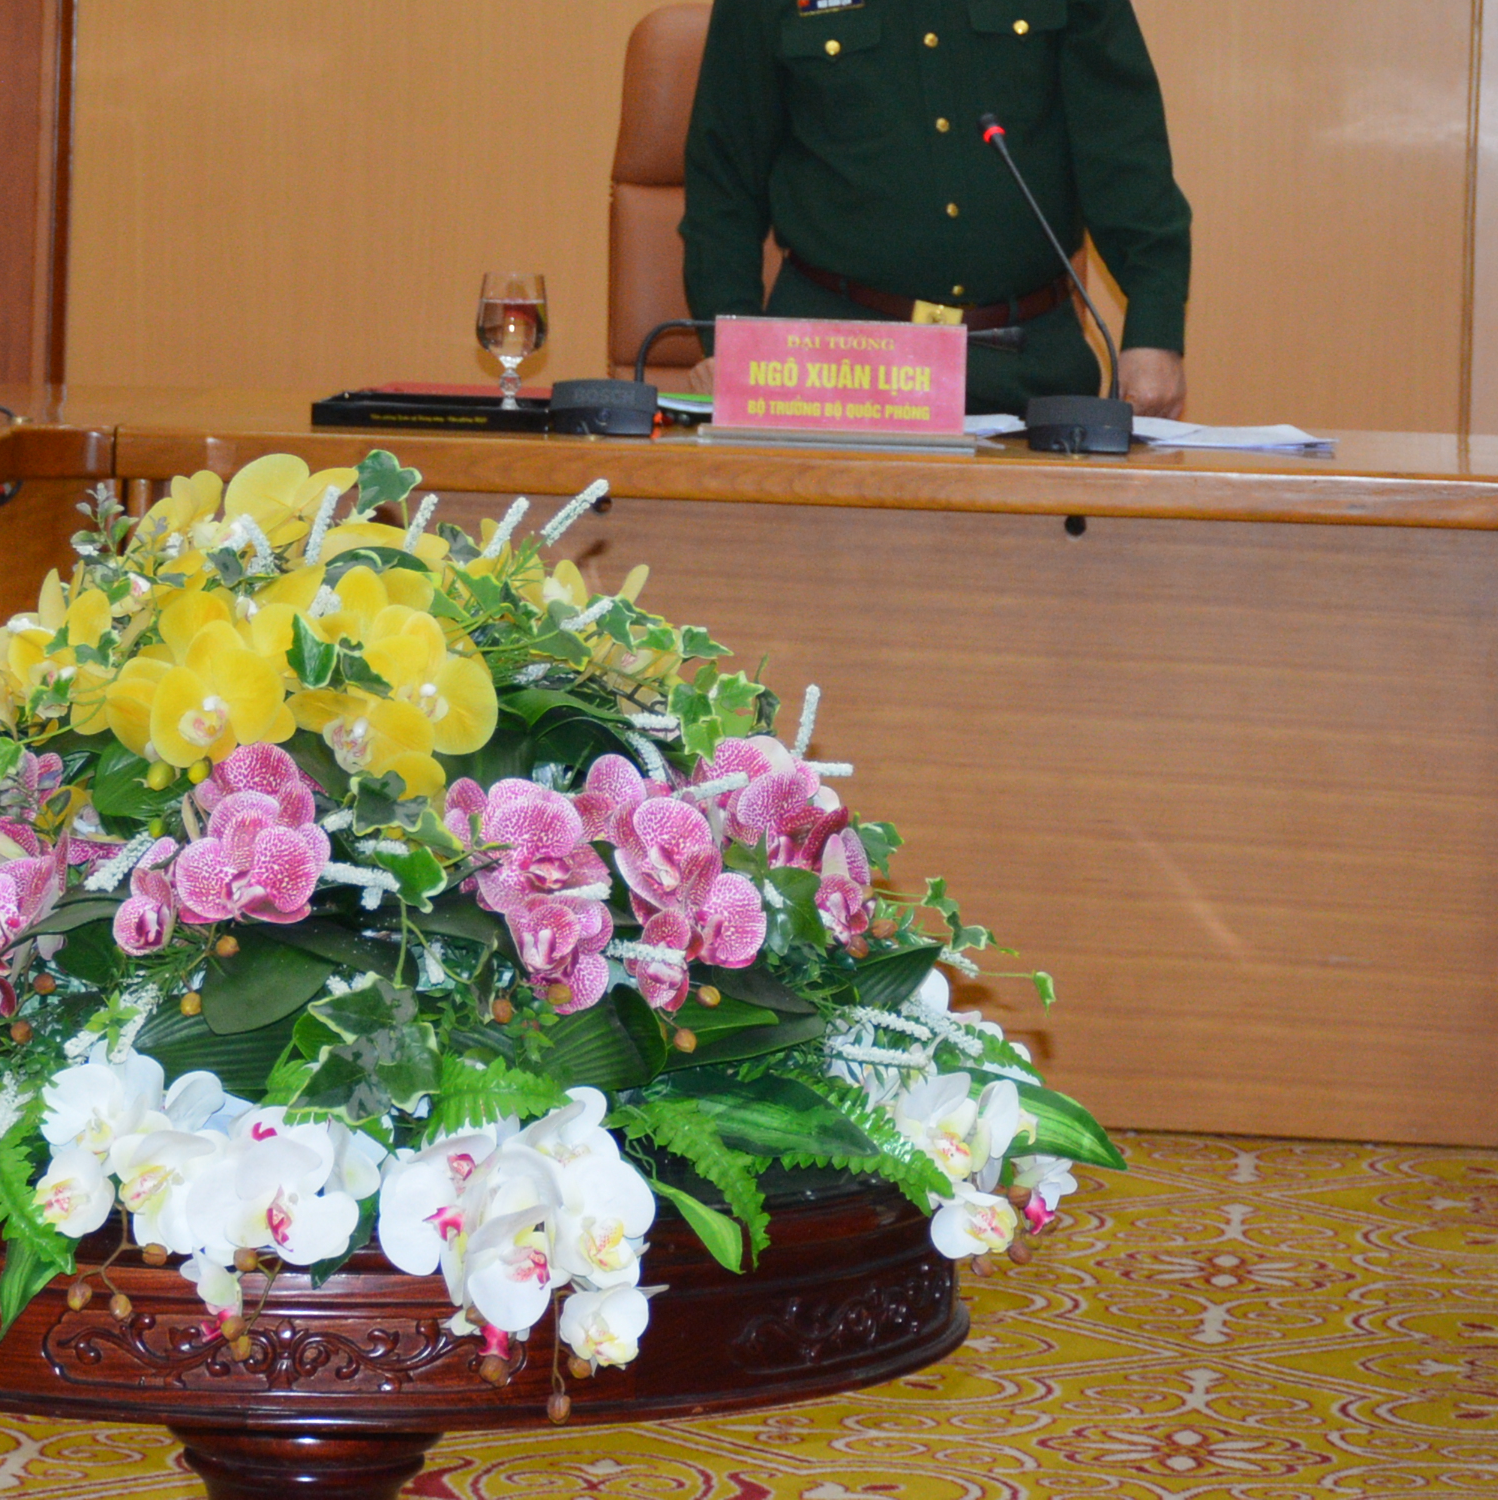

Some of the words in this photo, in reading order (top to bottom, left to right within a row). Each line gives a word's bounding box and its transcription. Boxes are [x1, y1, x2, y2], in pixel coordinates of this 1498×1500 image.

[787, 334, 820, 351] ĐẠI
[749, 357, 799, 387] NGÔ
[806, 358, 871, 390] XUÂN
[878, 365, 931, 396] LỊCH
[747, 397, 766, 417] BỘ
[770, 395, 821, 417] TRƯỞNG
[824, 400, 843, 420] BỘ
[846, 399, 881, 419] QUỐC
[884, 402, 931, 421] PHÒNG
